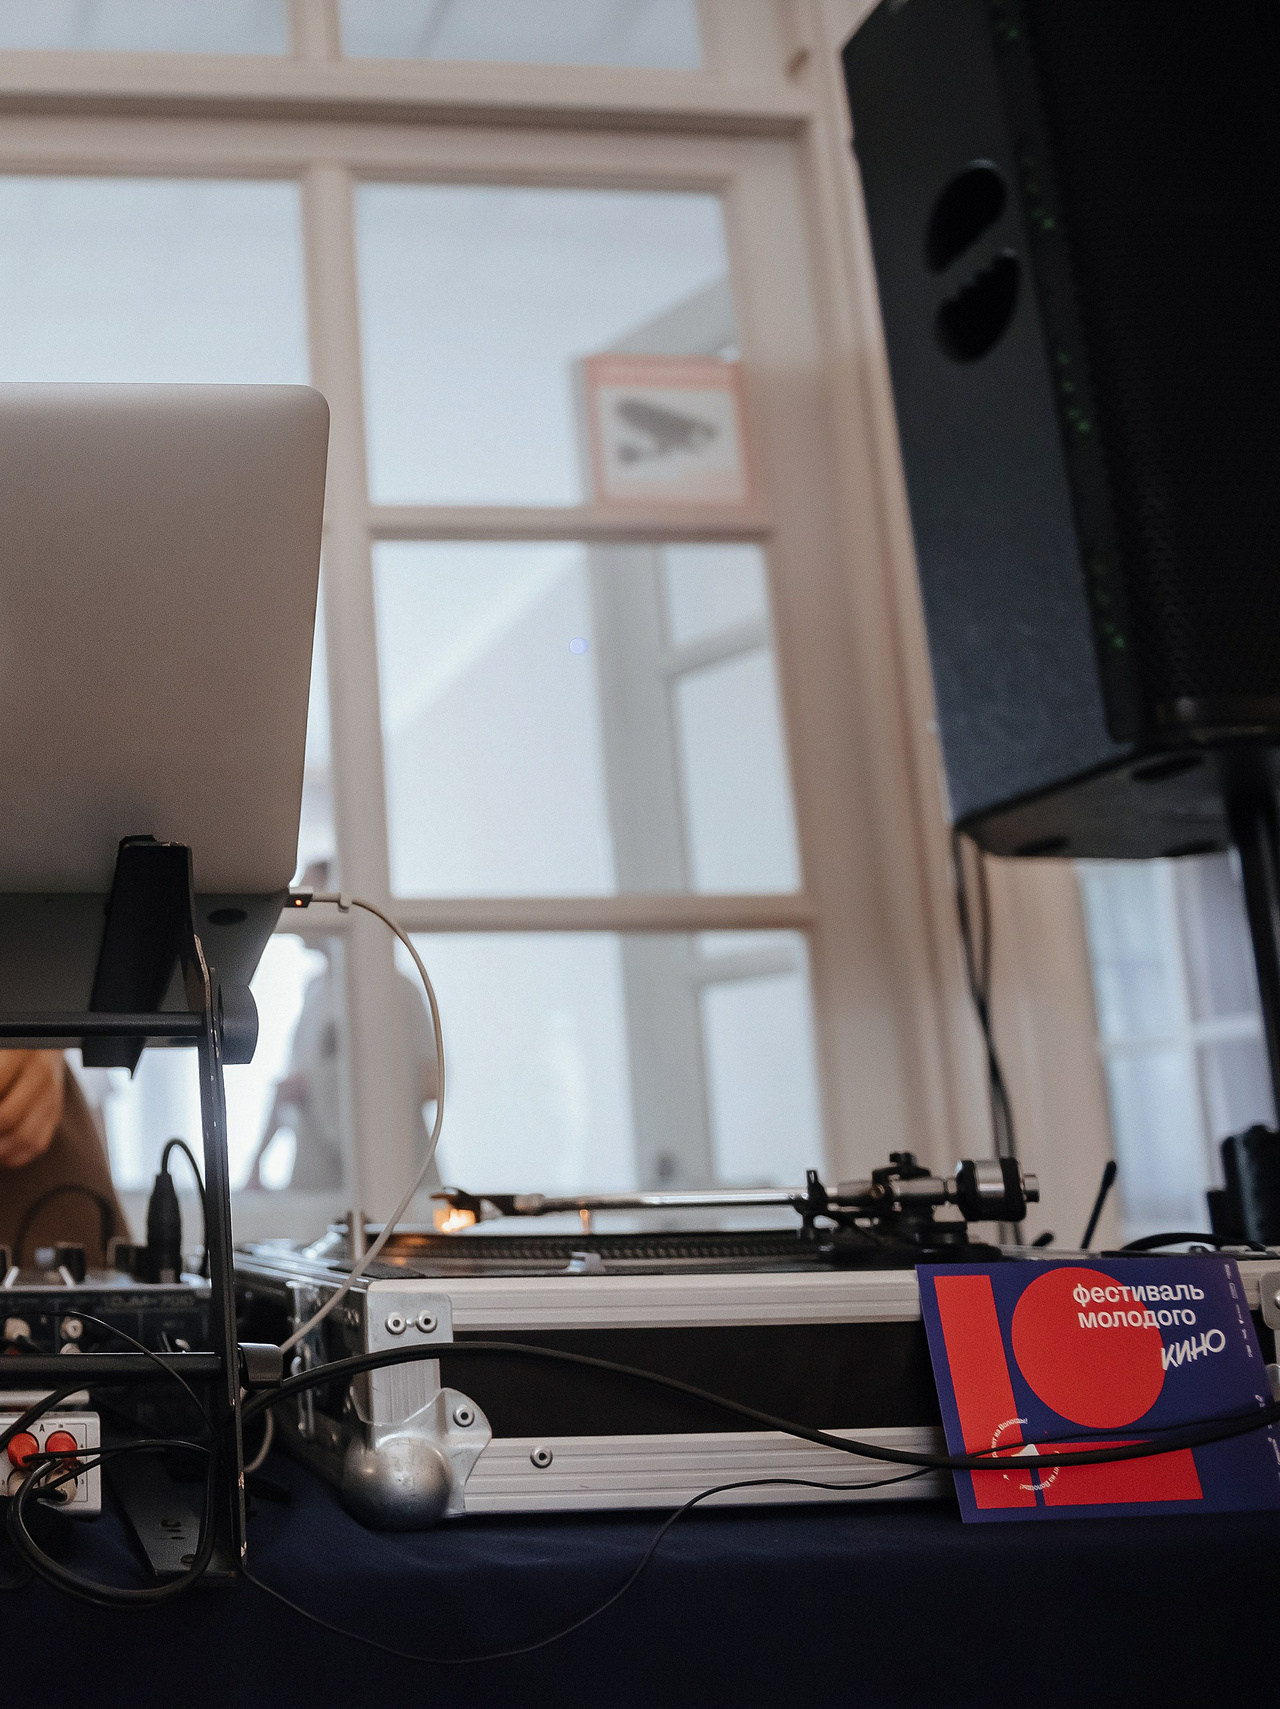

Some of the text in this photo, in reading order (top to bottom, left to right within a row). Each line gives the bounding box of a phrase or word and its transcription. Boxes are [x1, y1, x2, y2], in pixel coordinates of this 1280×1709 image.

[1072, 1282, 1205, 1307] фестиваль
[1077, 1308, 1197, 1330] молодого
[39, 1424, 45, 1433] A
